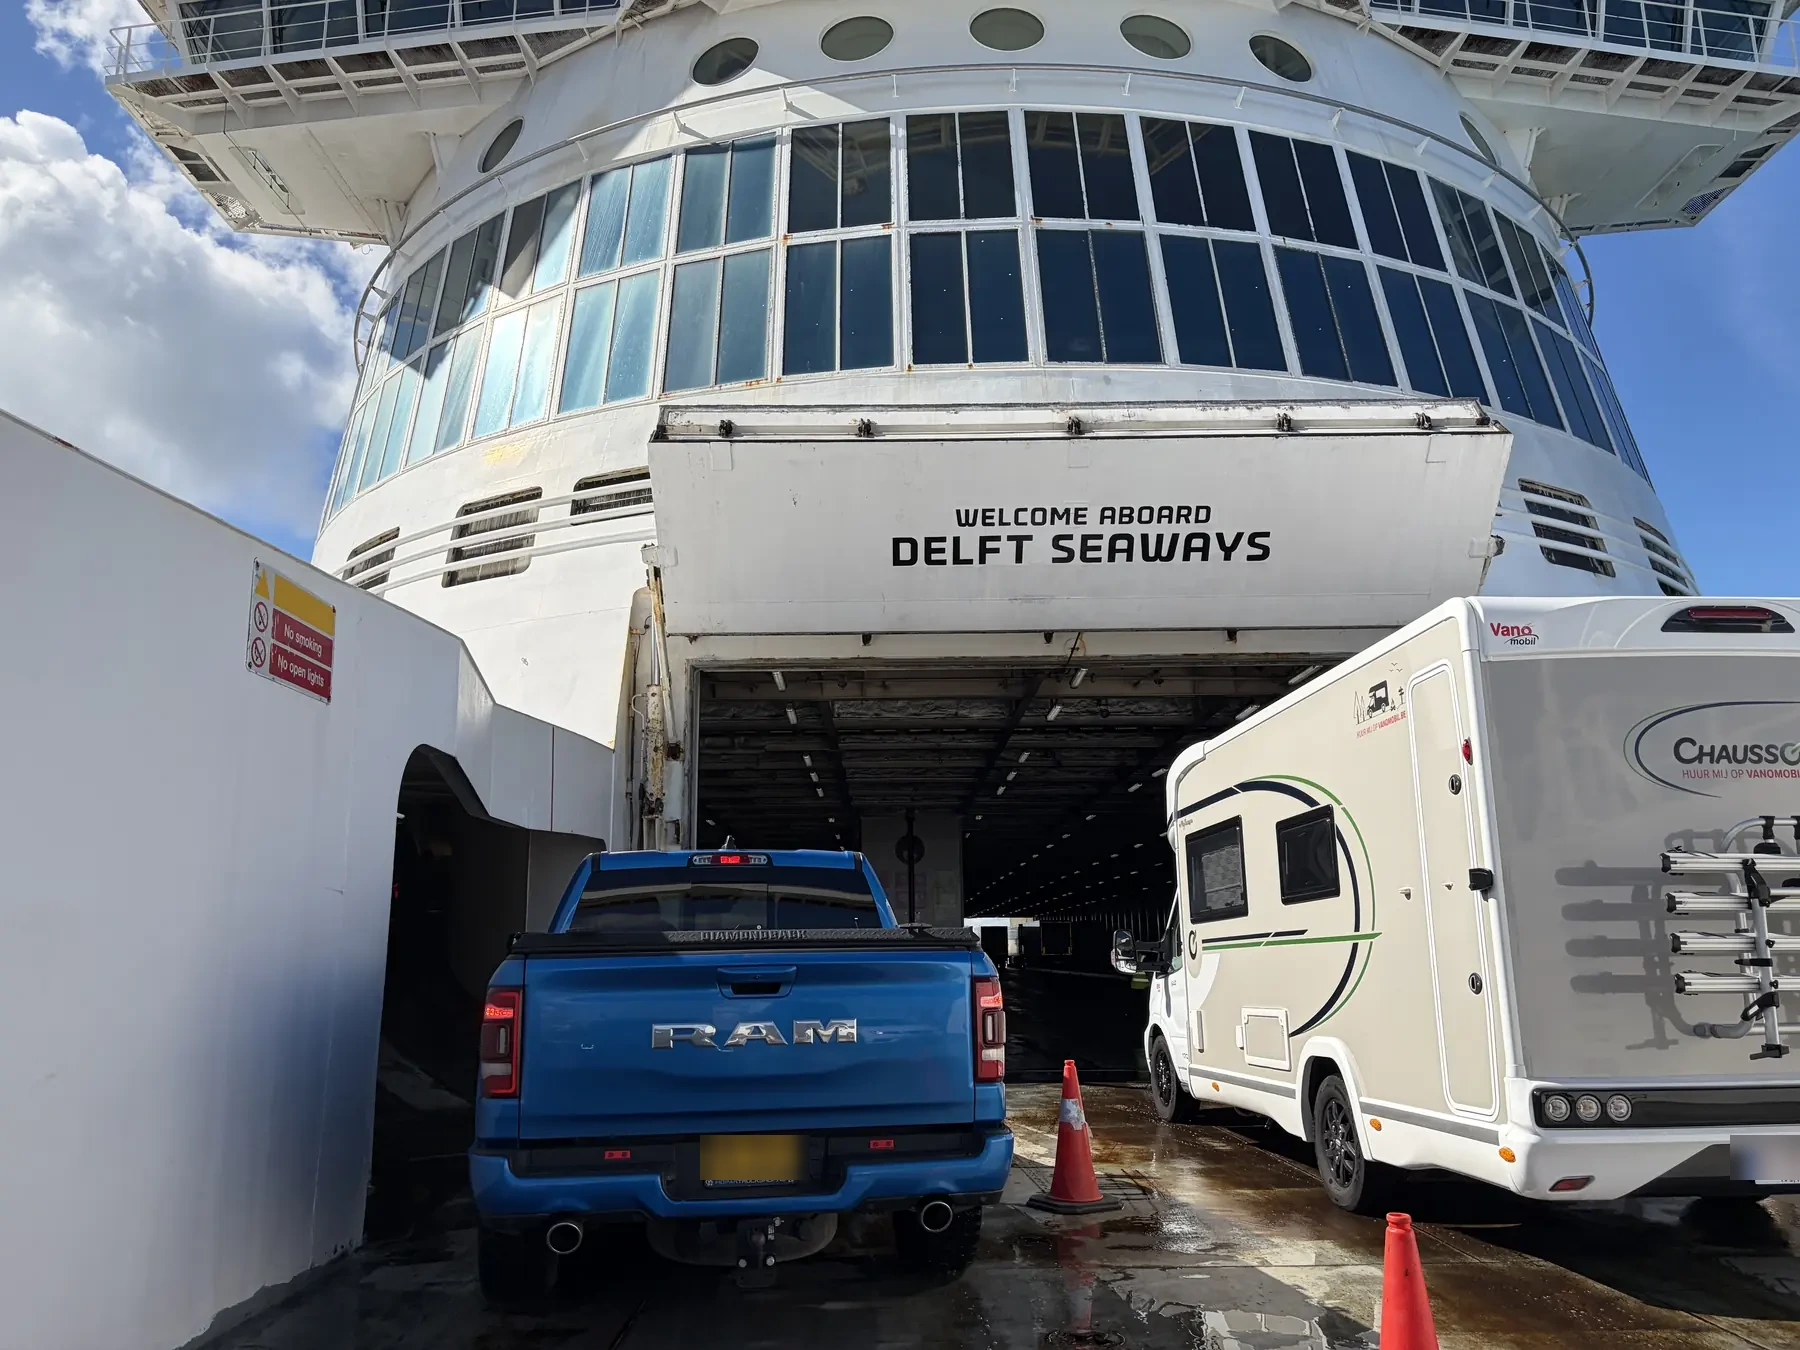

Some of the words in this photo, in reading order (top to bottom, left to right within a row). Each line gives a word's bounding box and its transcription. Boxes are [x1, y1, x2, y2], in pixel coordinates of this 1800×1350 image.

[956, 507, 1088, 527] WELCOME
[1099, 505, 1212, 524] ABOARD
[891, 534, 1033, 566] DELFT
[1051, 531, 1271, 564] SEAWAYS
[284, 624, 294, 639] No
[295, 632, 322, 657] smoking
[1490, 622, 1532, 637] Vano
[1510, 637, 1536, 646] mobil
[277, 654, 288, 671] No
[289, 664, 306, 678] open
[307, 669, 324, 687] lights
[1682, 769, 1710, 779] HUUR
[1712, 769, 1728, 779] MIJ
[1730, 769, 1744, 779] OP
[700, 929, 808, 941] DIAMONDBACK
[652, 1018, 858, 1049] RAM
